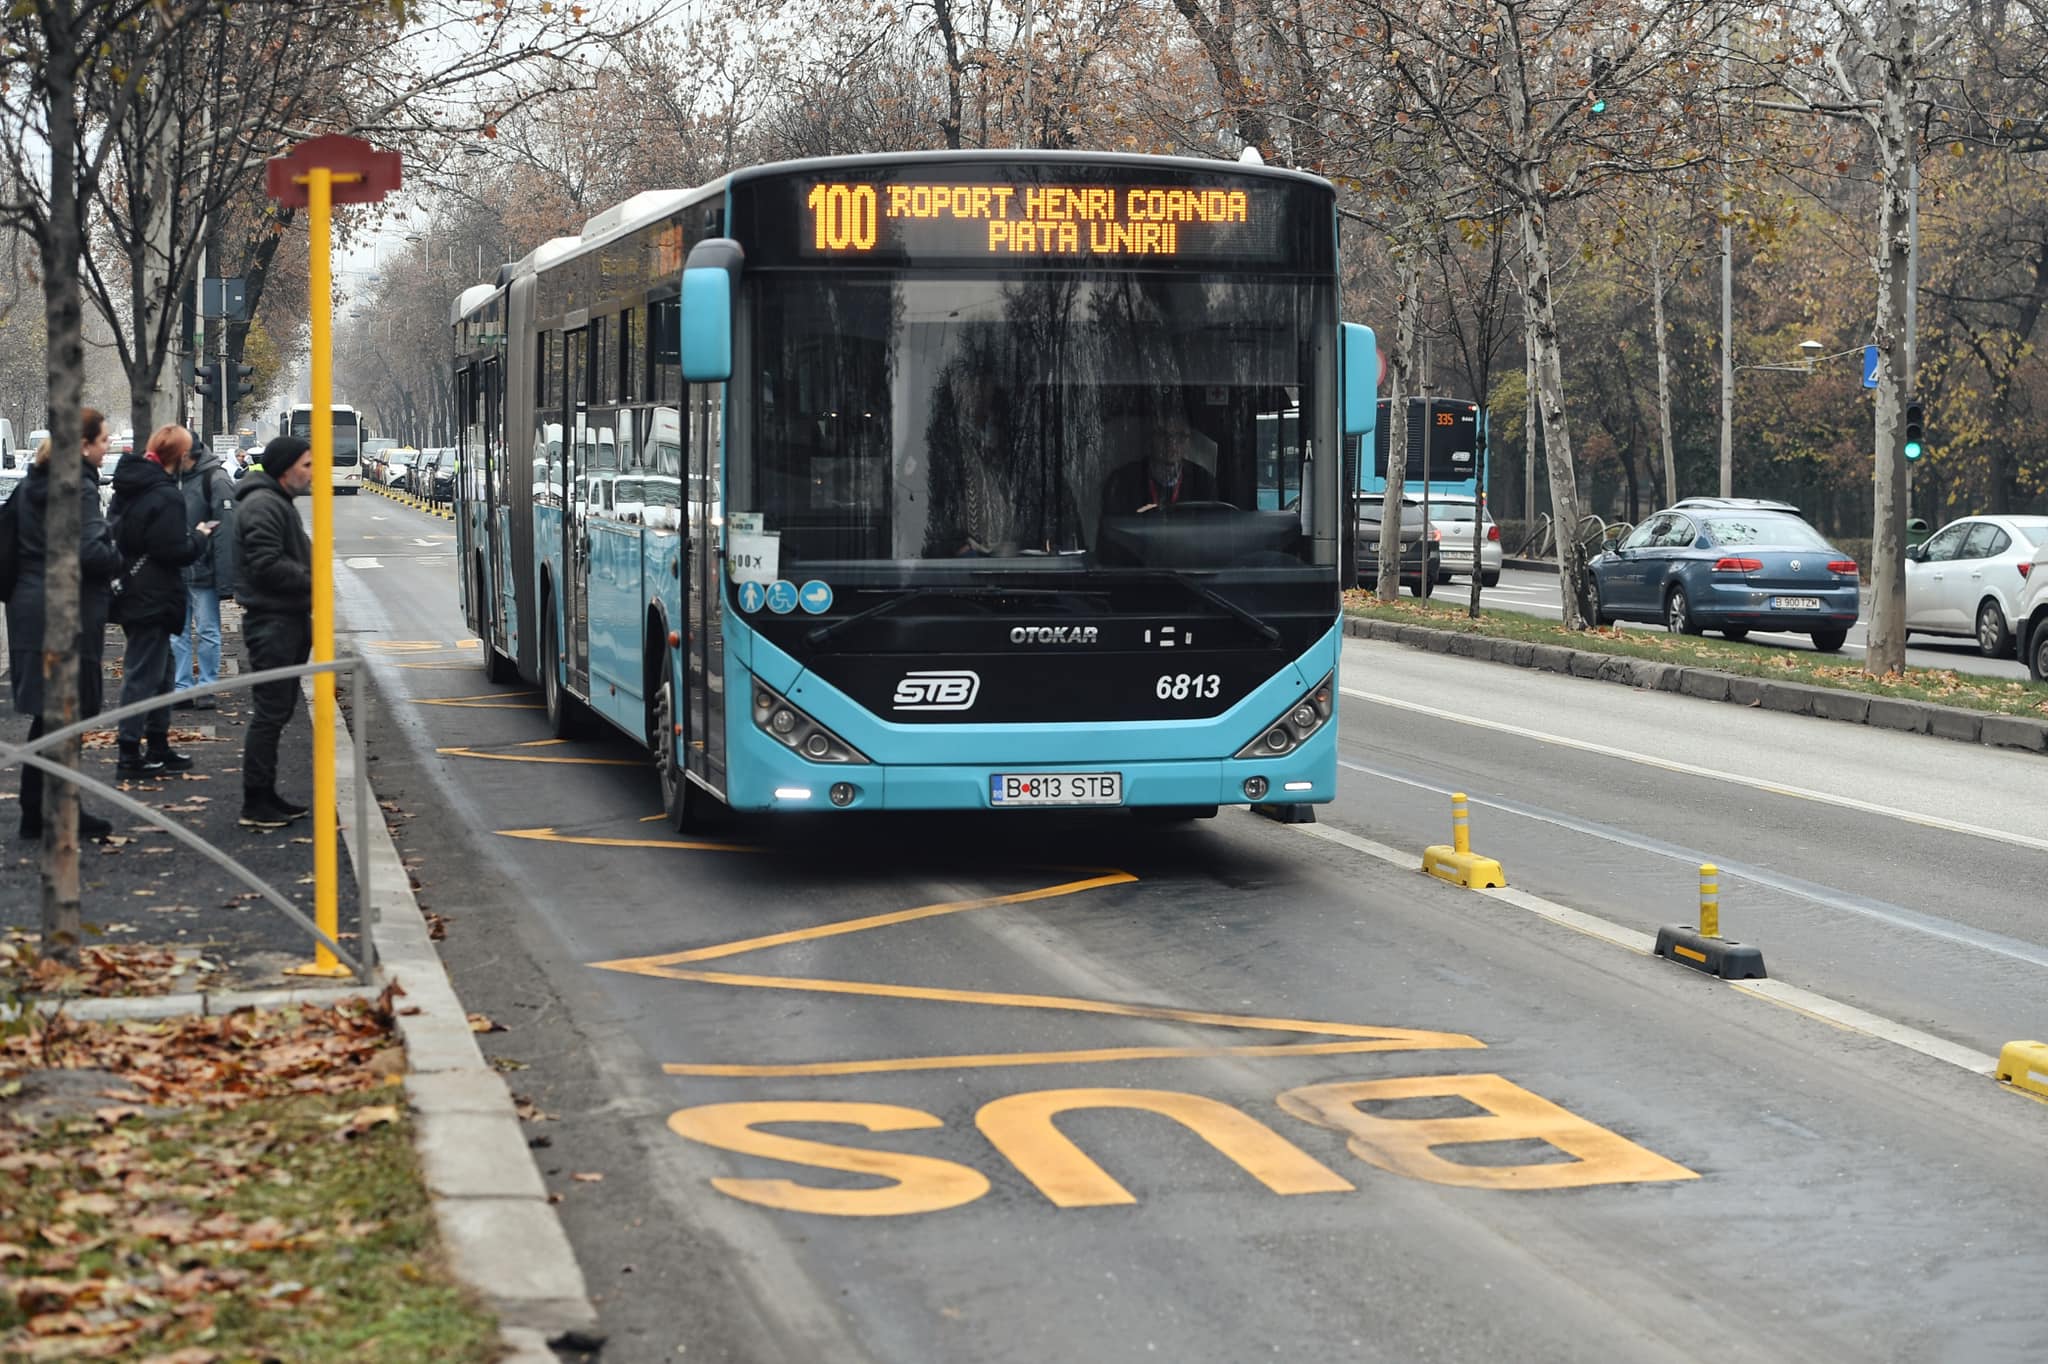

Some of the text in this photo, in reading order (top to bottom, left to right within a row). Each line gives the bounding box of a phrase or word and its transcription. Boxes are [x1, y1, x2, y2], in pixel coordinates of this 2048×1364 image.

[808, 184, 877, 250] 100
[886, 185, 1247, 222] ROPORT HENRI COANDA
[988, 220, 1176, 254] PIATA UNIRII
[1436, 413, 1454, 425] 335
[1010, 626, 1099, 644] OTOKAR
[893, 677, 973, 705] STB
[1156, 673, 1221, 700] 6813
[1007, 777, 1115, 798] B 813 STB
[667, 1072, 1702, 1217] BUS
